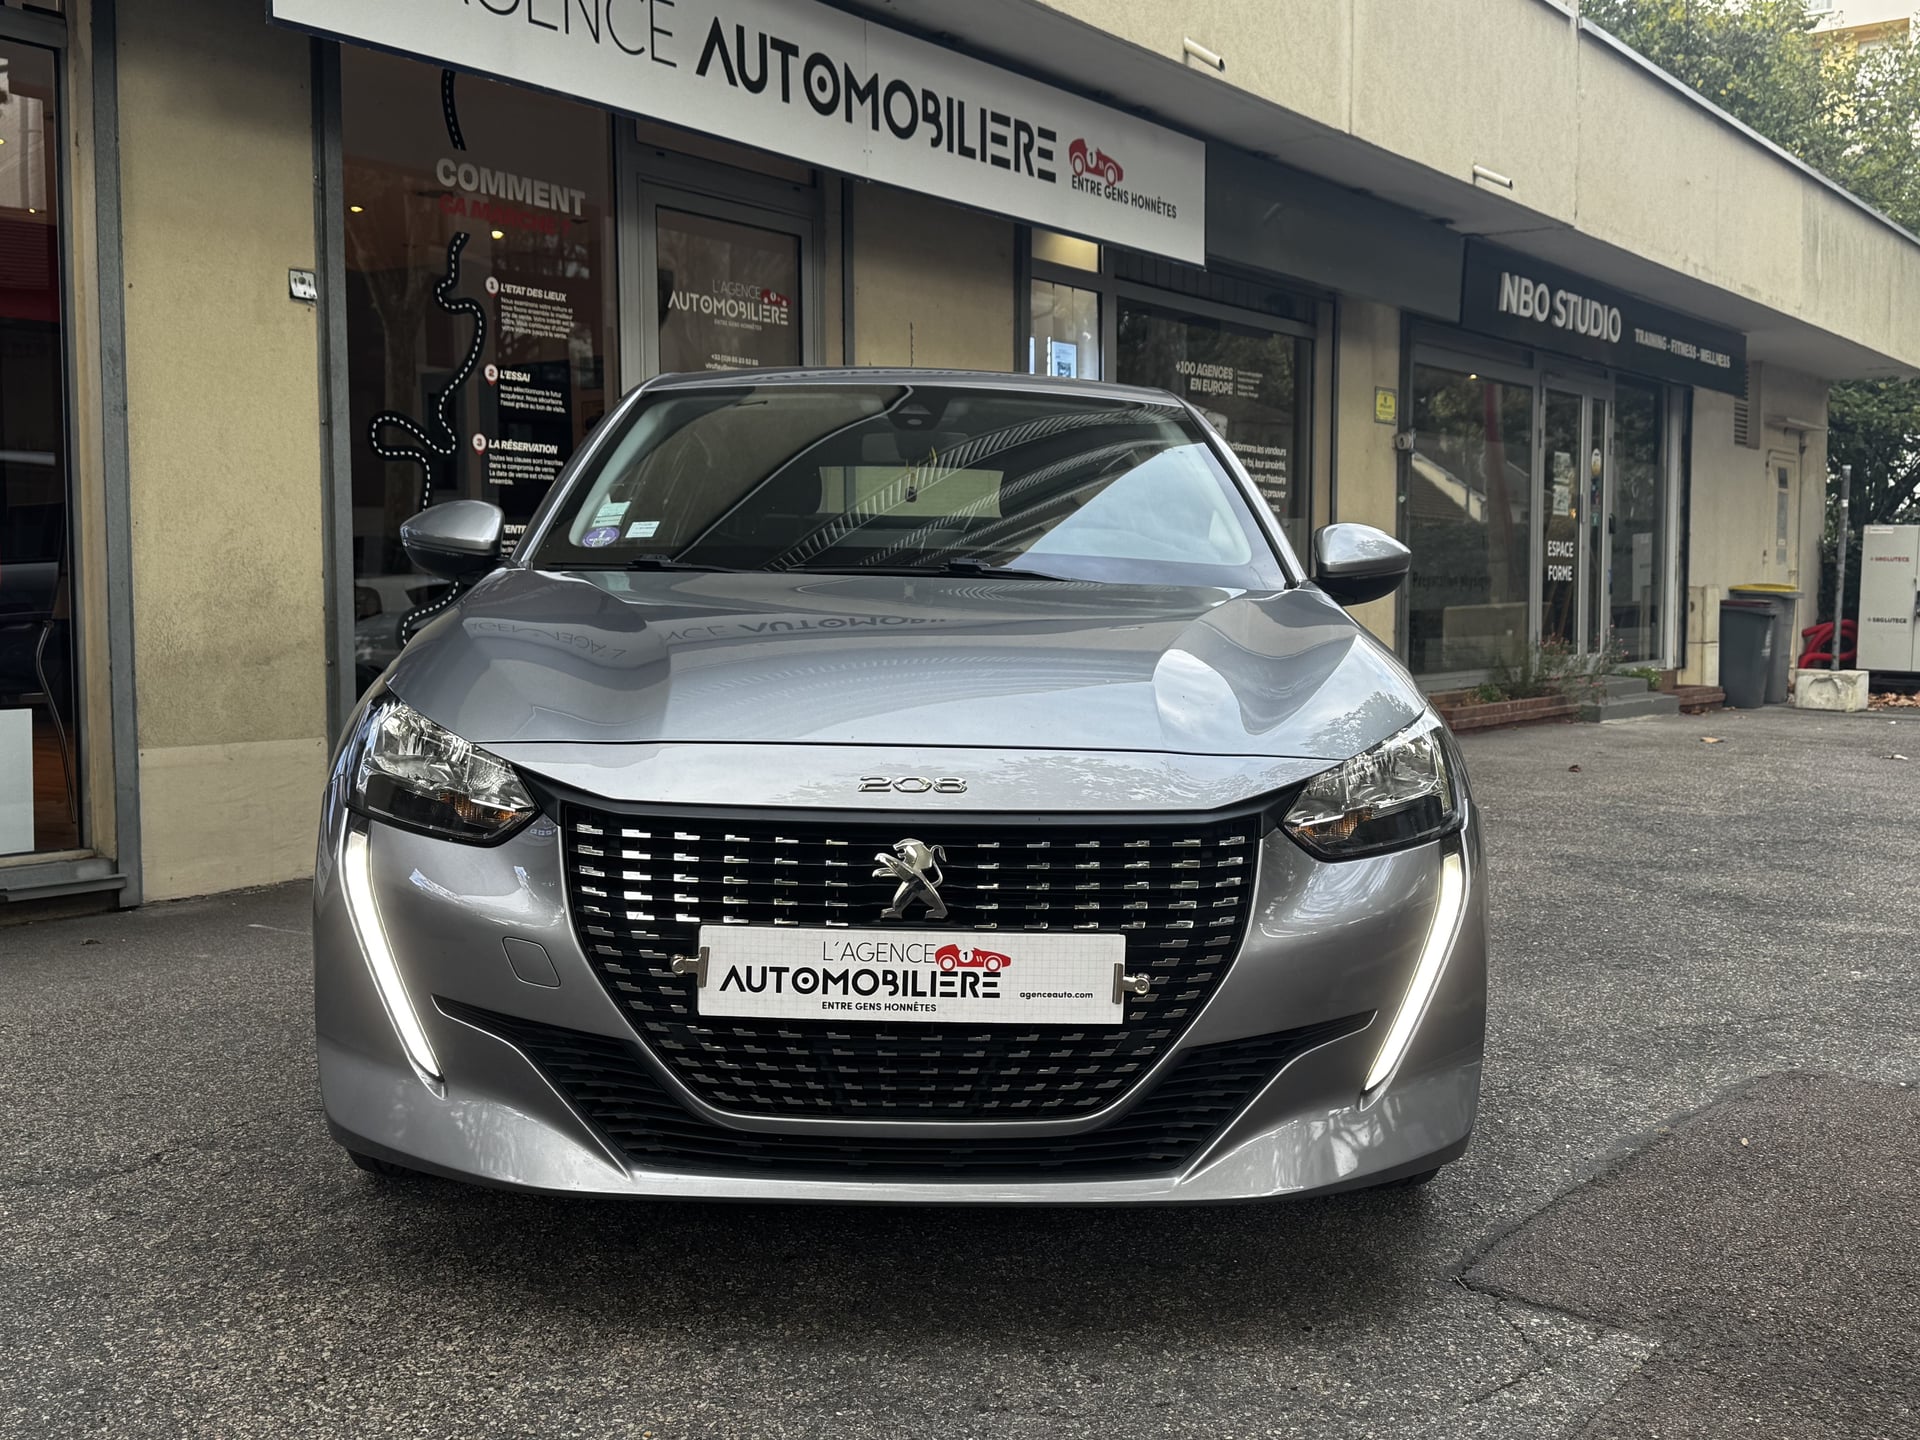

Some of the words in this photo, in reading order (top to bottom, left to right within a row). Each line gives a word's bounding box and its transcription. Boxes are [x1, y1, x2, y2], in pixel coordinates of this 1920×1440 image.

[695, 16, 1057, 184] AUTOMOBILIERE
[436, 158, 586, 216] COMMENT
[1072, 174, 1102, 197] ENTRE
[1104, 184, 1129, 205] GENS
[1131, 192, 1177, 219] HONNÊTES
[500, 283, 526, 296] L'ETAT
[527, 287, 543, 298] DES
[544, 290, 567, 302] LIEUX
[712, 279, 760, 300] L'AGENCE
[668, 290, 788, 325] AUTOMOBILIERE
[1499, 271, 1550, 322] NBO
[1551, 289, 1622, 344] STUDIO
[1634, 328, 1667, 351] TRAINING
[1671, 338, 1697, 360] FITNESS
[1700, 348, 1731, 369] WELLNESS
[500, 369, 531, 383] L'ESSAI
[1175, 360, 1196, 375] +100
[1197, 363, 1233, 380] AGENCES
[1190, 377, 1201, 391] EN
[1202, 379, 1233, 395] EUROPE
[488, 439, 500, 449] LA
[501, 438, 558, 455] RÉSERVATION
[1548, 540, 1574, 557] ESPACE
[1548, 565, 1573, 582] FORME
[857, 775, 968, 793] 208
[823, 941, 936, 964] L'AGENCE
[719, 965, 1001, 998] AUTOMOBILIERE
[1019, 991, 1093, 1000] agenceauto.com
[822, 1001, 853, 1010] ENTRE
[855, 1002, 882, 1011] GENS
[884, 1001, 937, 1012] HONNÊTES
